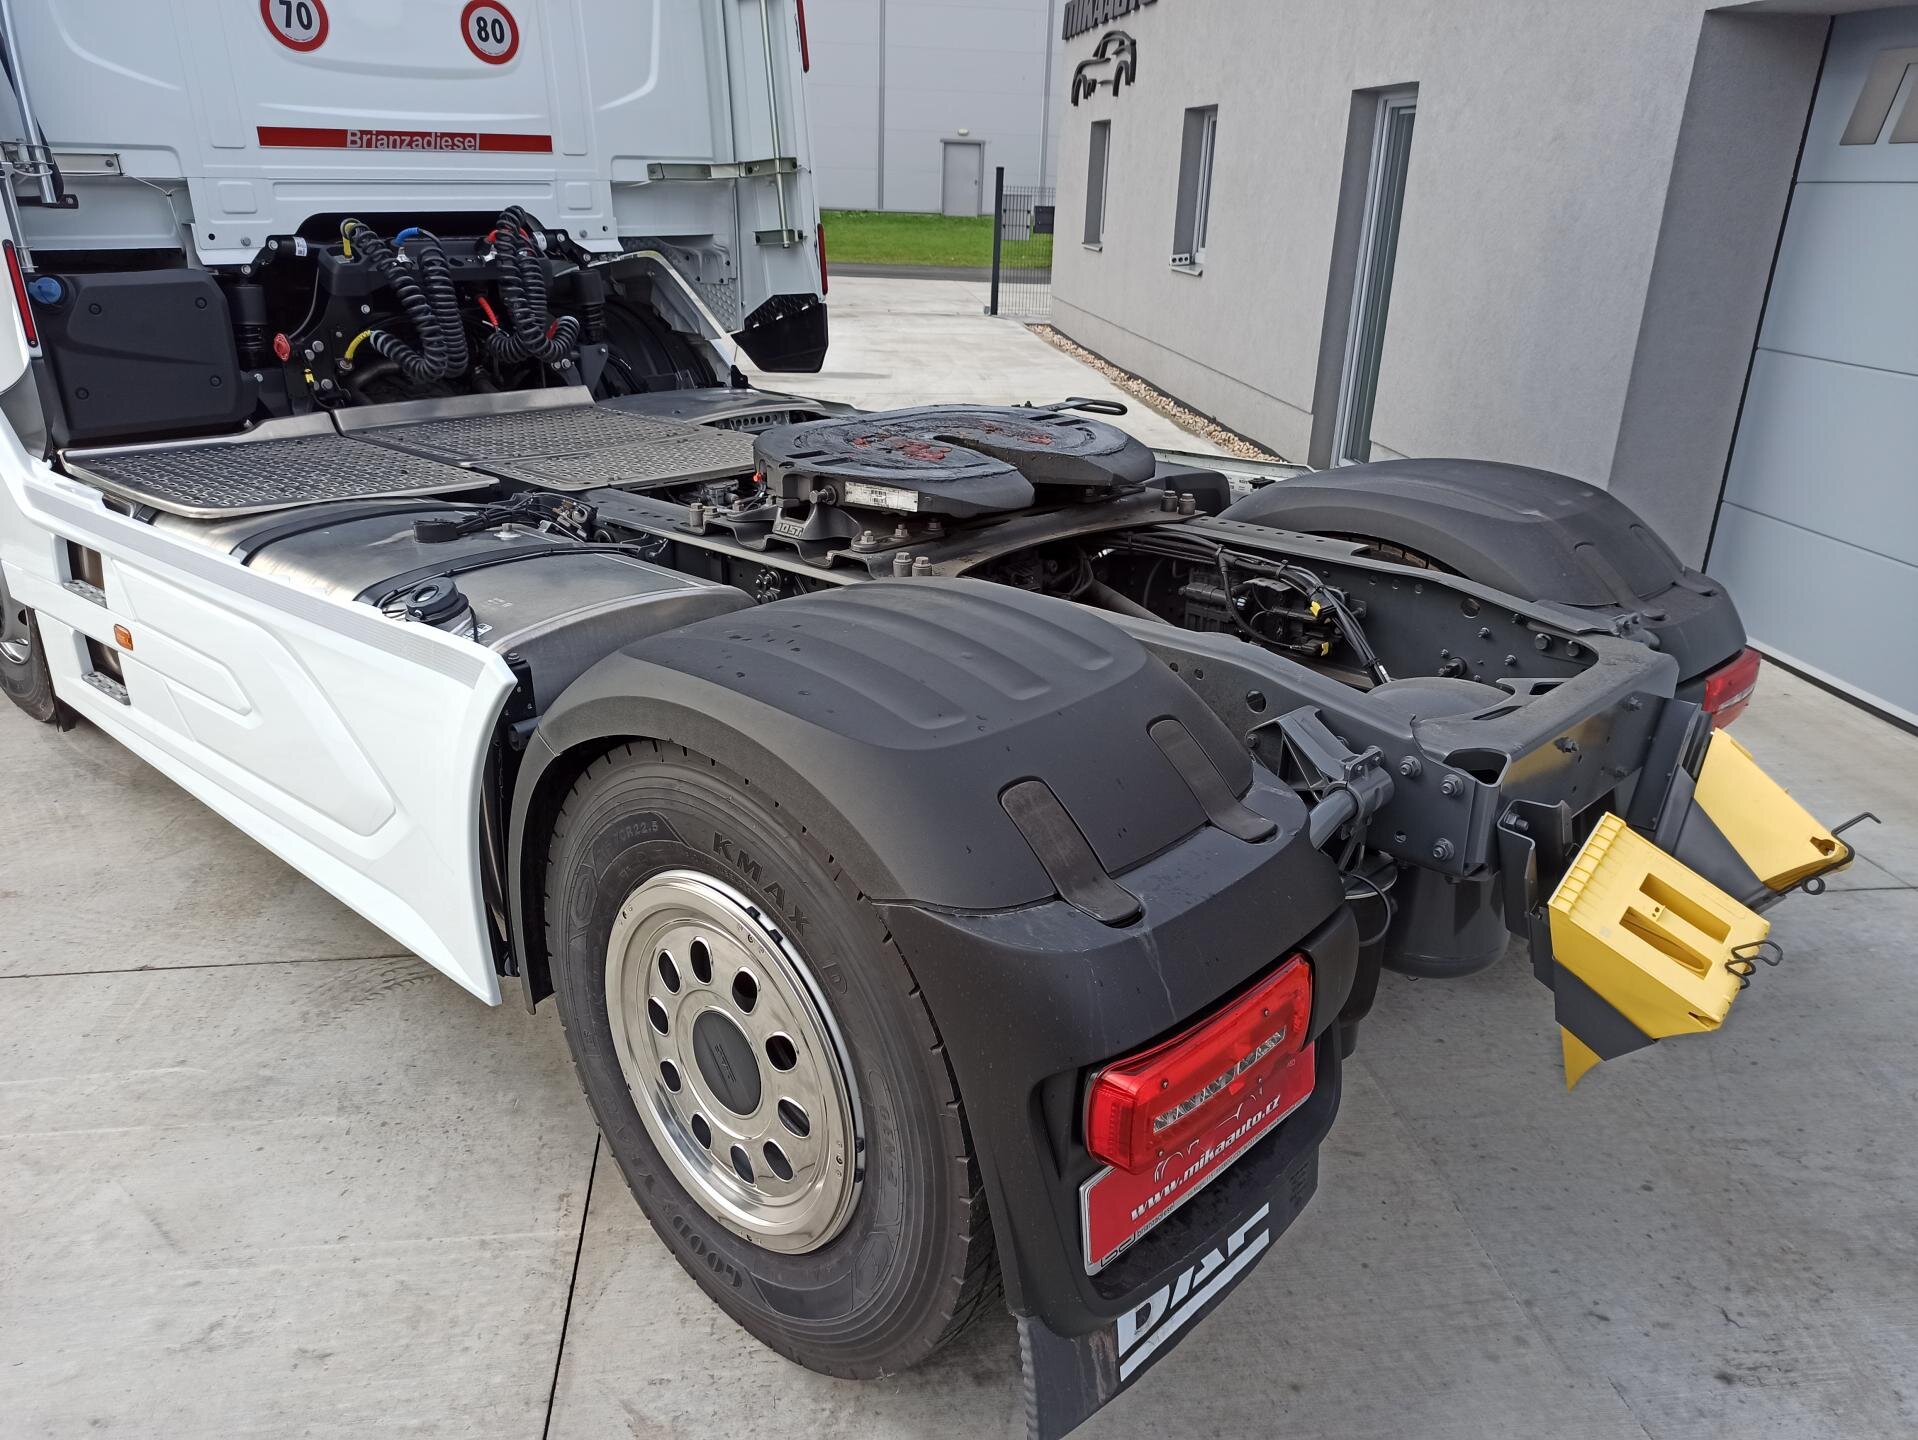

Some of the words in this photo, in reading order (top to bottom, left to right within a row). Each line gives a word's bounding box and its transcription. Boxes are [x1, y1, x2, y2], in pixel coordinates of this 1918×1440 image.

[279, 0, 313, 31] 70
[476, 16, 505, 44] 80
[346, 130, 481, 151] Brianzadiesel
[775, 523, 803, 537] JOST
[712, 831, 810, 937] KMAX
[1130, 1094, 1282, 1222] www.mikaauto.cz
[1116, 1200, 1270, 1359] DAF
